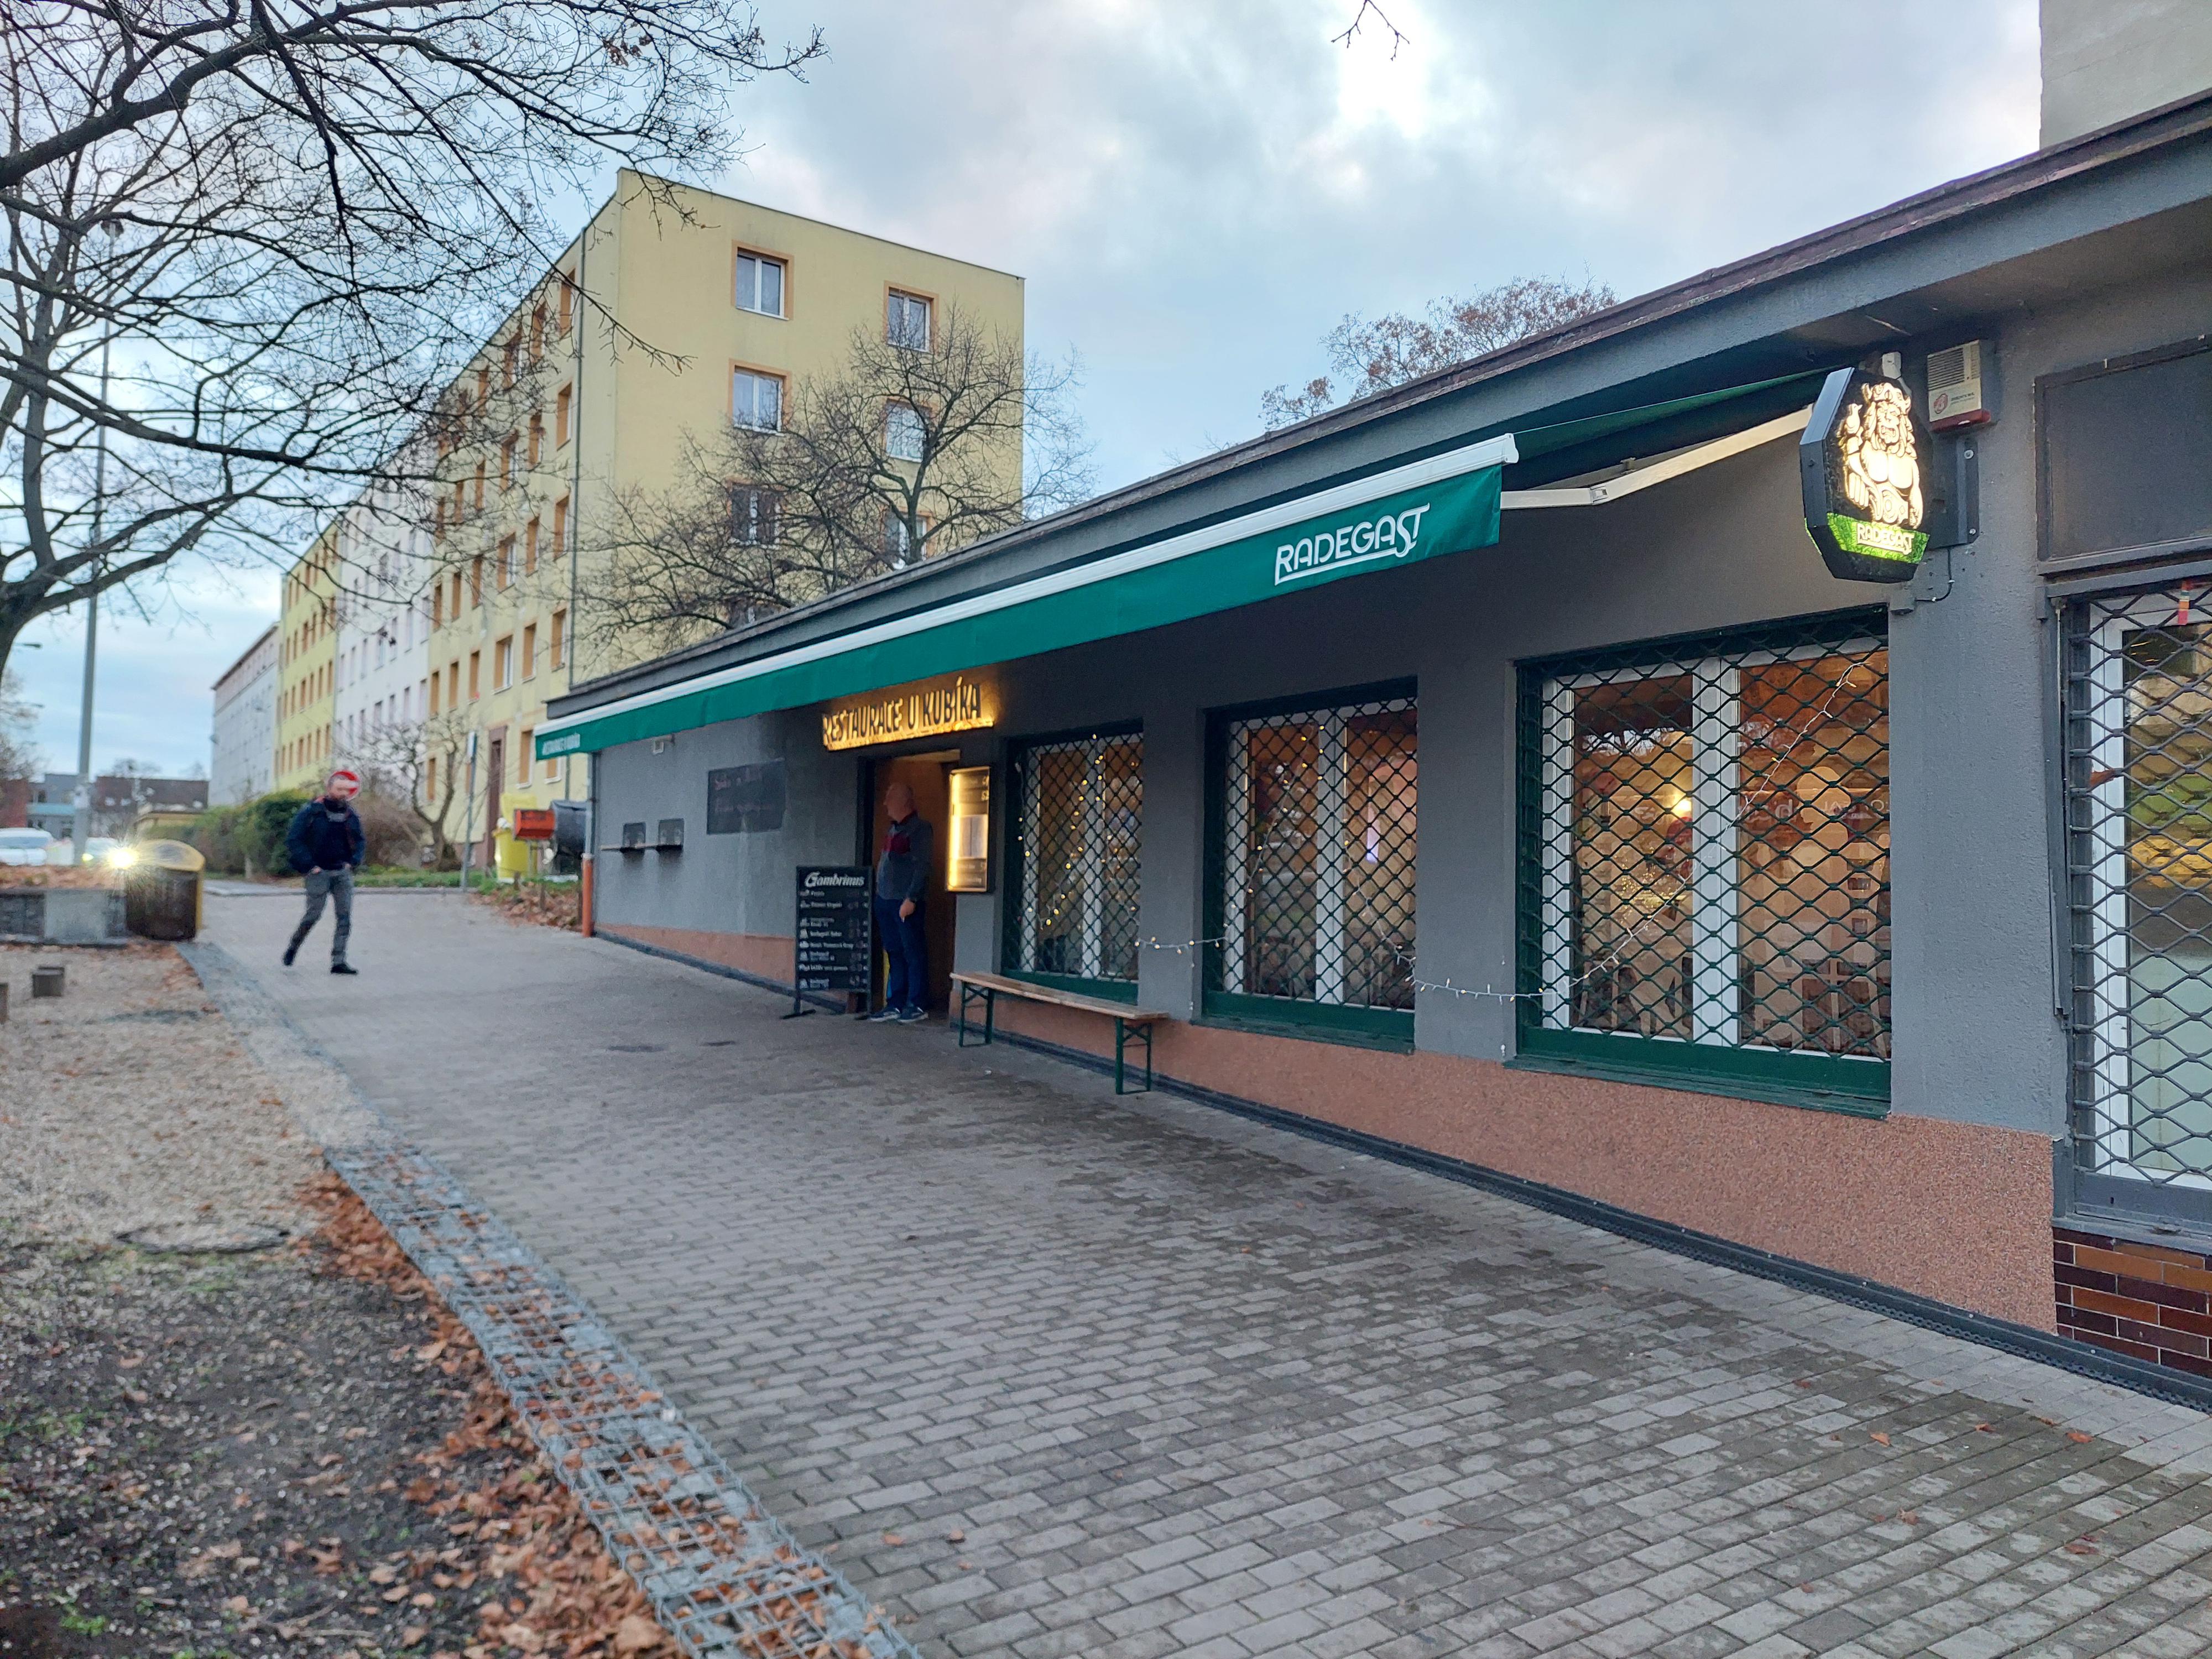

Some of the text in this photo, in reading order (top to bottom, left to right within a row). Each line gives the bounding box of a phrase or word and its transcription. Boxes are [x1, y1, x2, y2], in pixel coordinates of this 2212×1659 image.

[1275, 502, 1430, 586] RADEGAST
[1856, 523, 1915, 555] RADEGAST
[822, 676, 982, 744] RESTAURACE U KUBÍKA
[805, 872, 864, 887] Gambrinus
